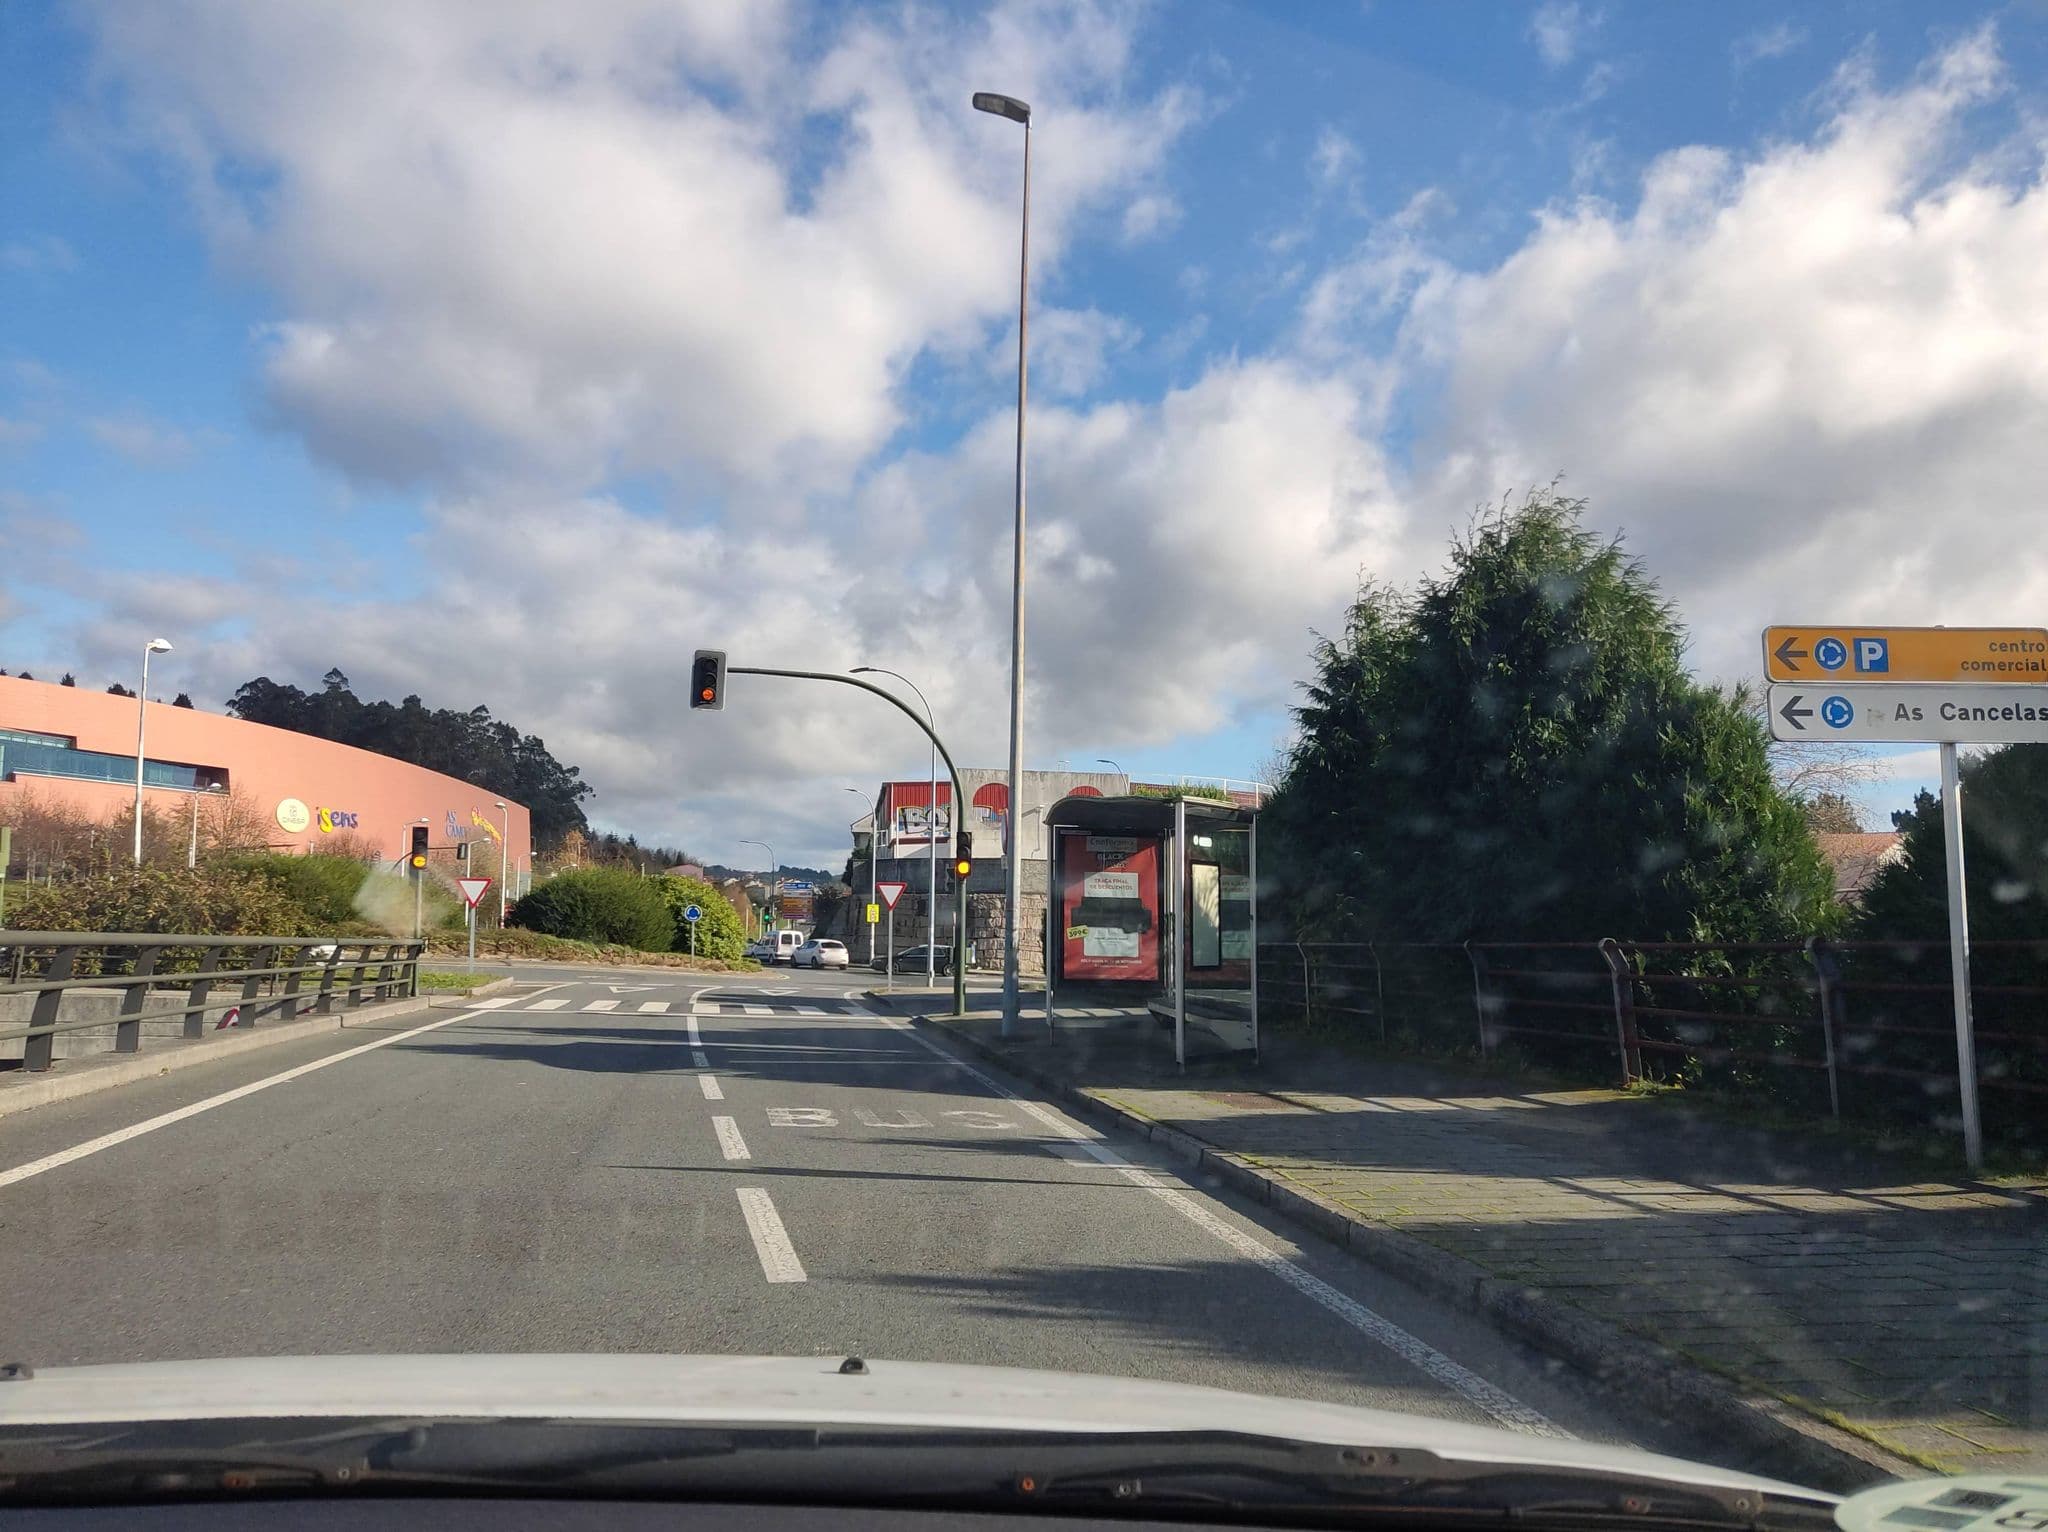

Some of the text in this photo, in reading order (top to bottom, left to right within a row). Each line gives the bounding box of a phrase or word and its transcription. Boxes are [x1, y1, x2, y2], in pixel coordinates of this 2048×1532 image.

[1861, 641, 1884, 670] P
[1988, 639, 2045, 653] centro
[1960, 658, 2046, 672] comercial
[1894, 702, 2048, 722] As Cancelas
[766, 1107, 1019, 1129] BUS
